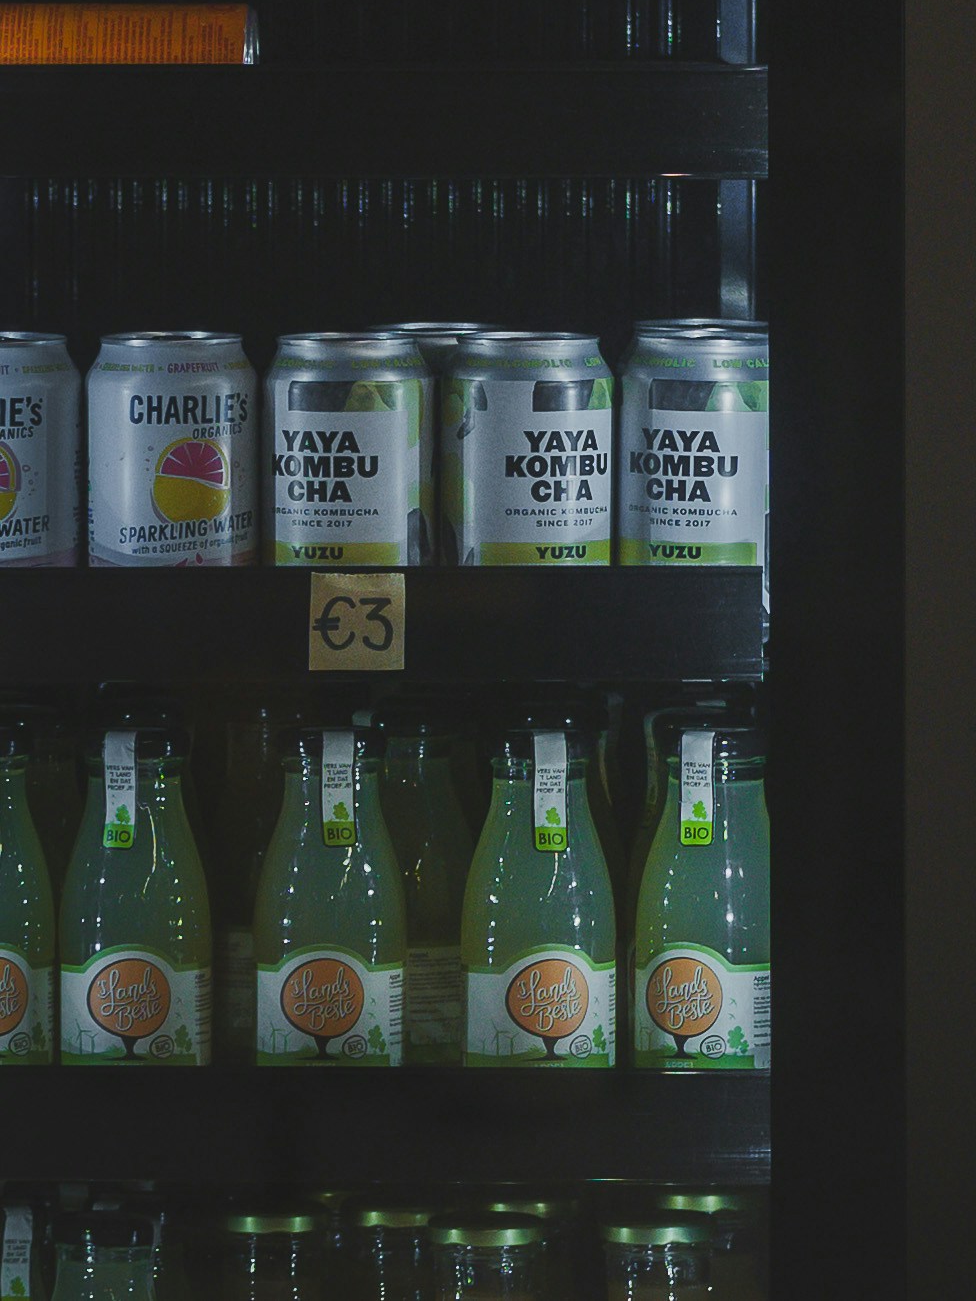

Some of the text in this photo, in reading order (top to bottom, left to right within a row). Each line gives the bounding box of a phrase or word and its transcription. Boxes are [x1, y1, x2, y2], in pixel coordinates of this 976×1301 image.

[167, 362, 220, 374] GRAPEFRUIT
[129, 393, 248, 426] CHARLIE'S
[192, 423, 242, 440] ORGANICS
[281, 430, 361, 453] YAYA
[523, 429, 598, 453] YAYA
[641, 427, 720, 453] YAYA
[272, 453, 379, 478] KOMBU
[504, 453, 608, 478] KOMBU
[629, 451, 738, 478] KOMBU
[287, 479, 352, 503] CHA
[530, 479, 593, 503] CHA
[645, 477, 711, 503] CHA
[313, 508, 379, 517] KOMBUCHA
[561, 505, 608, 516] KOMBUCHA
[672, 507, 738, 517] KOMBUCHA
[0, 514, 50, 537] WATER
[119, 510, 253, 544] SPARKLING WATER
[291, 519, 353, 528] SINCE 2017
[535, 518, 593, 528] SINCE 2017
[649, 518, 711, 528] SINCE 2017
[22, 535, 42, 548] fruit
[159, 541, 198, 554] SQUEEZE
[199, 539, 208, 550] of
[648, 543, 702, 560] YUZU
[291, 545, 344, 560] YUZU
[535, 545, 586, 560] YUZU
[312, 595, 394, 652] €3
[106, 829, 131, 843] BIO
[327, 828, 352, 841] BIO
[538, 832, 563, 846] BIO
[684, 827, 709, 840] BIO
[114, 995, 162, 1031] Beste
[308, 996, 355, 1031] Beste
[536, 998, 582, 1031] Beste
[666, 997, 714, 1029] Beste
